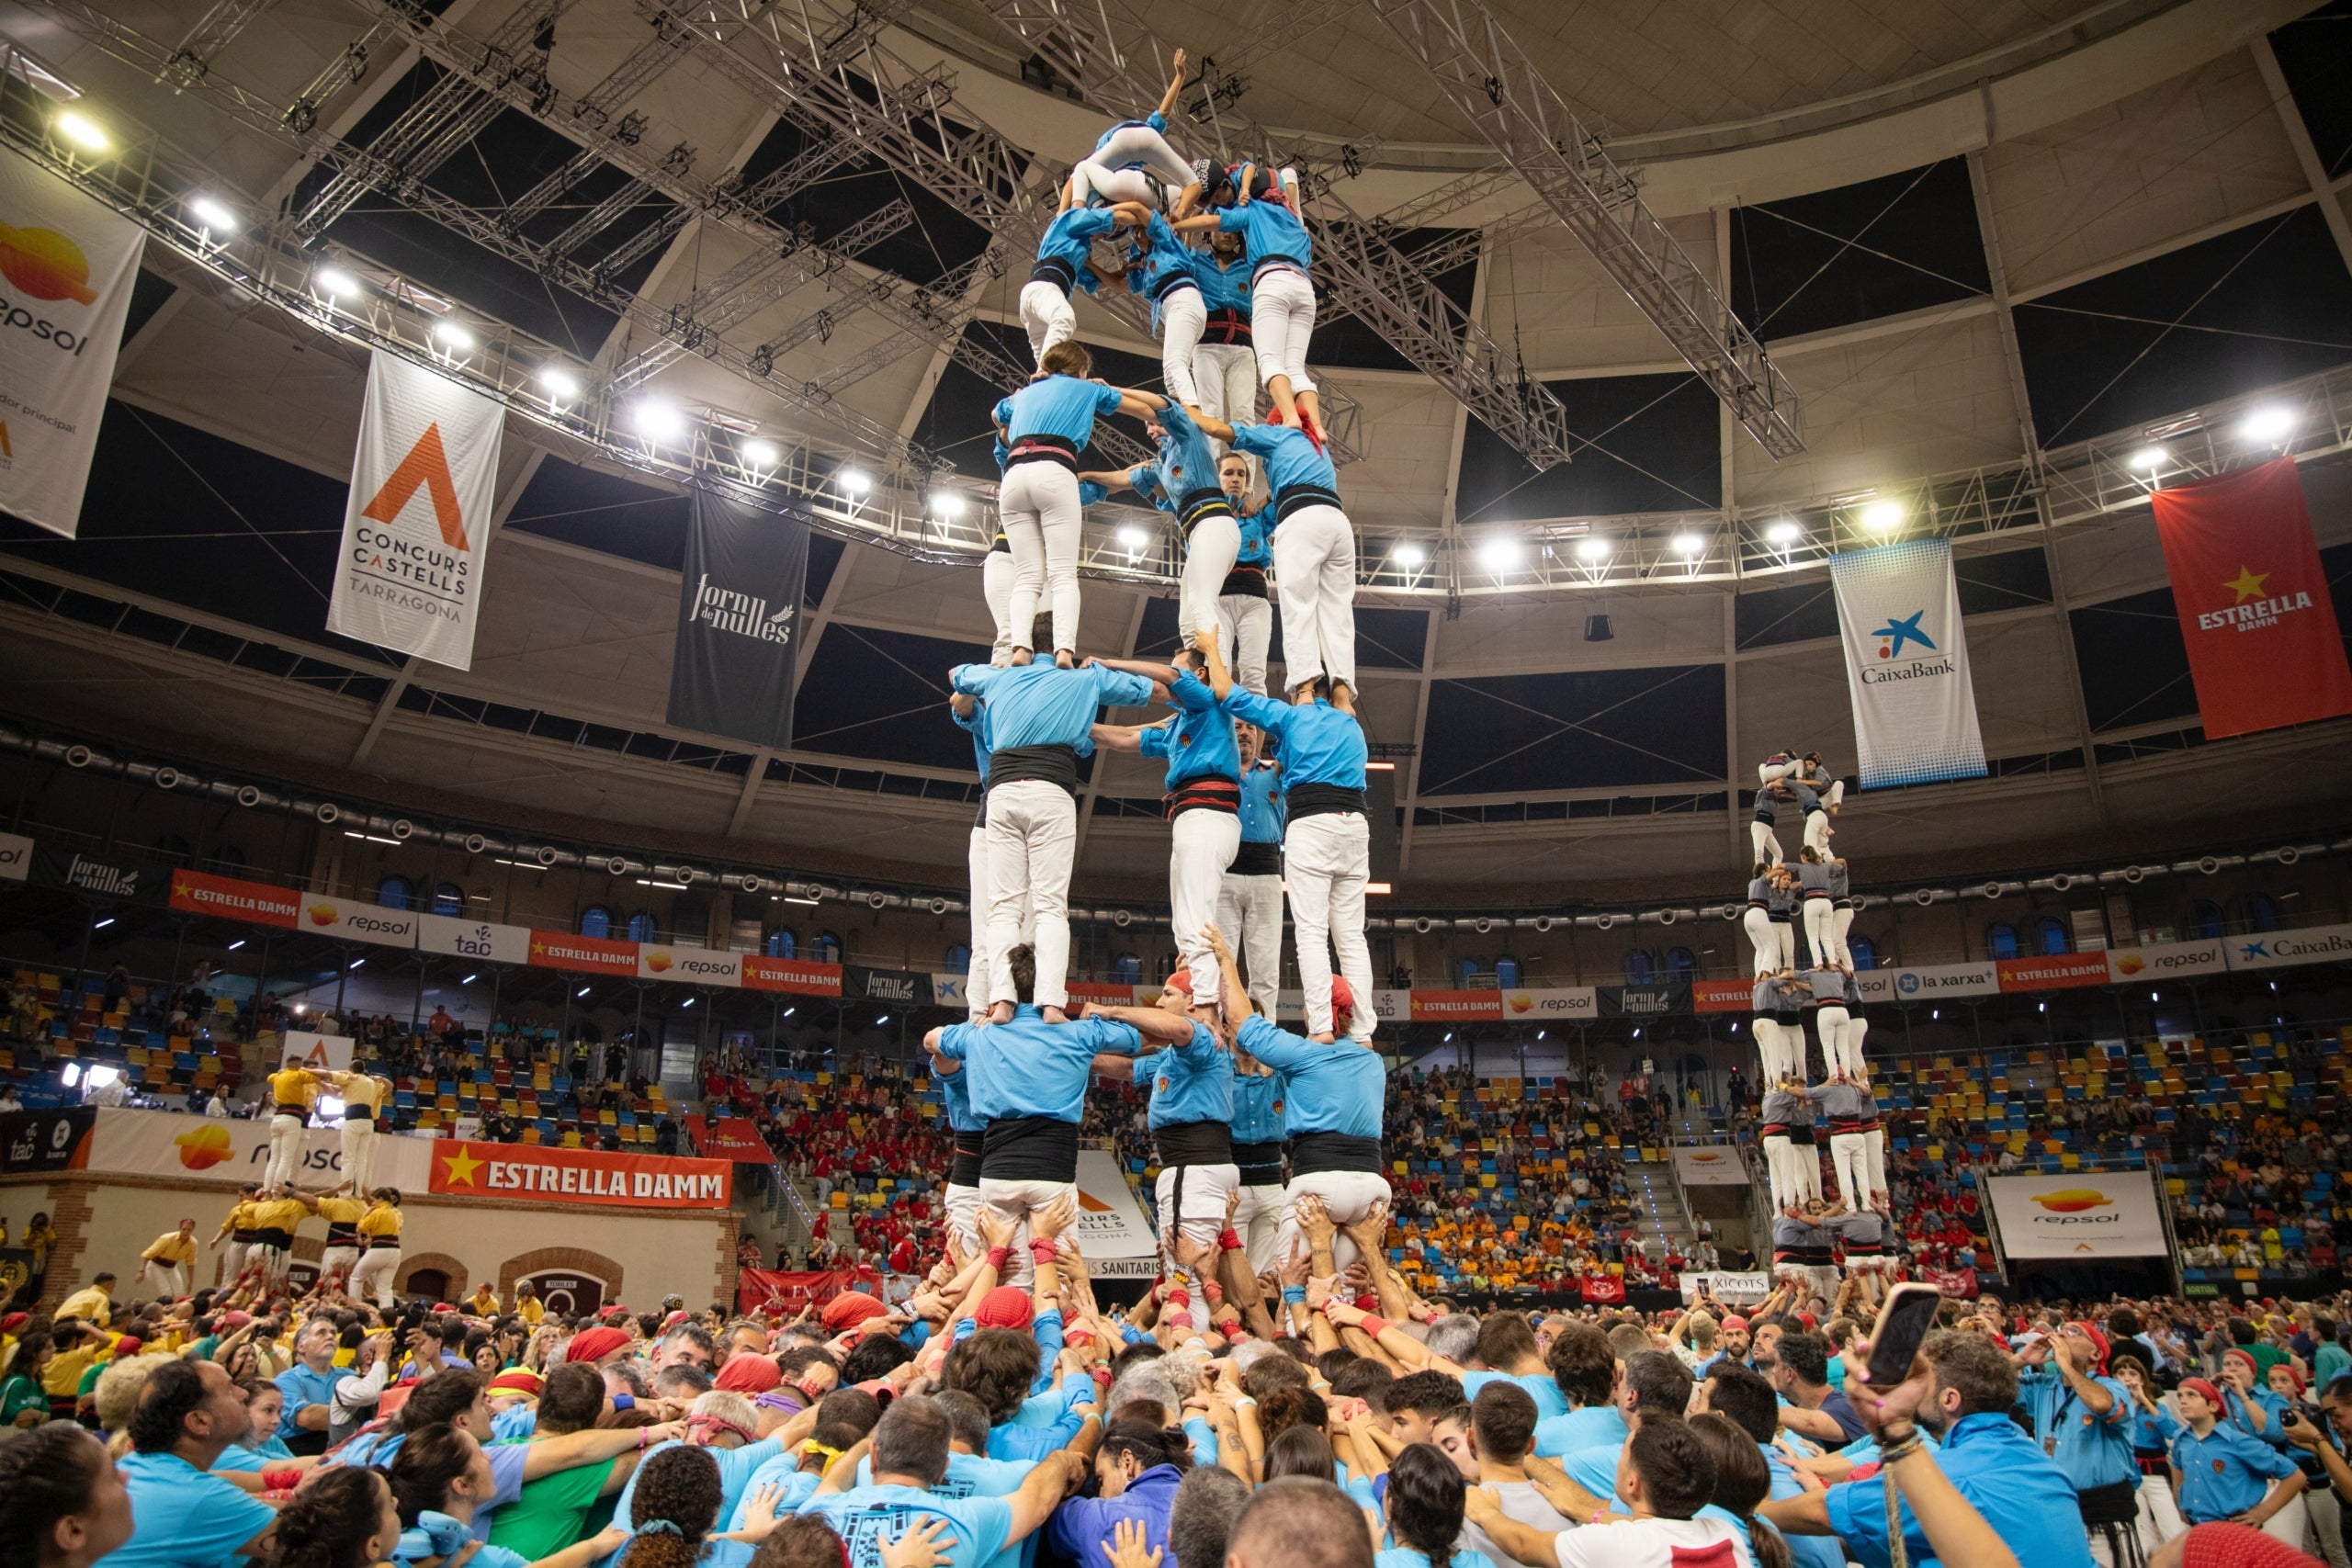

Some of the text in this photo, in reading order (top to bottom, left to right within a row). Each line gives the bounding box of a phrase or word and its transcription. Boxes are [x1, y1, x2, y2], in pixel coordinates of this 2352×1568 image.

[23, 406, 76, 434] principal
[356, 528, 468, 576] CONCURS
[354, 548, 465, 595] CASTELLS
[349, 577, 461, 623] TARRAGONA
[688, 573, 750, 621] forn
[701, 606, 714, 620] de
[710, 597, 790, 644] nulles
[2198, 592, 2312, 631] ESTRELLA
[2237, 615, 2278, 633] DAMM
[1860, 659, 1956, 684] CaixaBank
[193, 888, 297, 917] ESTRELLA DAMM
[347, 915, 411, 935] repsol
[455, 934, 492, 956] tac
[548, 946, 636, 965] ESTRELLA DAMM
[2154, 949, 2216, 968] repsol
[681, 959, 737, 976] repsol
[2016, 964, 2106, 981] ESTRELLA DAMM
[760, 970, 841, 987] ESTRELLA DAMM
[1859, 979, 1886, 992] sol
[1922, 976, 1937, 987] la
[1101, 997, 1131, 1006] DAMM
[1424, 1001, 1500, 1011] ESTRELLA DAMM
[1541, 996, 1591, 1011] repsol
[1374, 1006, 1395, 1017] ac
[10, 1139, 35, 1161] tac
[487, 1161, 724, 1200] ESTRELLA DAMM
[1079, 1213, 1121, 1222] URS
[2033, 1213, 2120, 1224] repsol
[1714, 1278, 1765, 1289] XICOTS
[2186, 1285, 2217, 1294] SORTIDA
